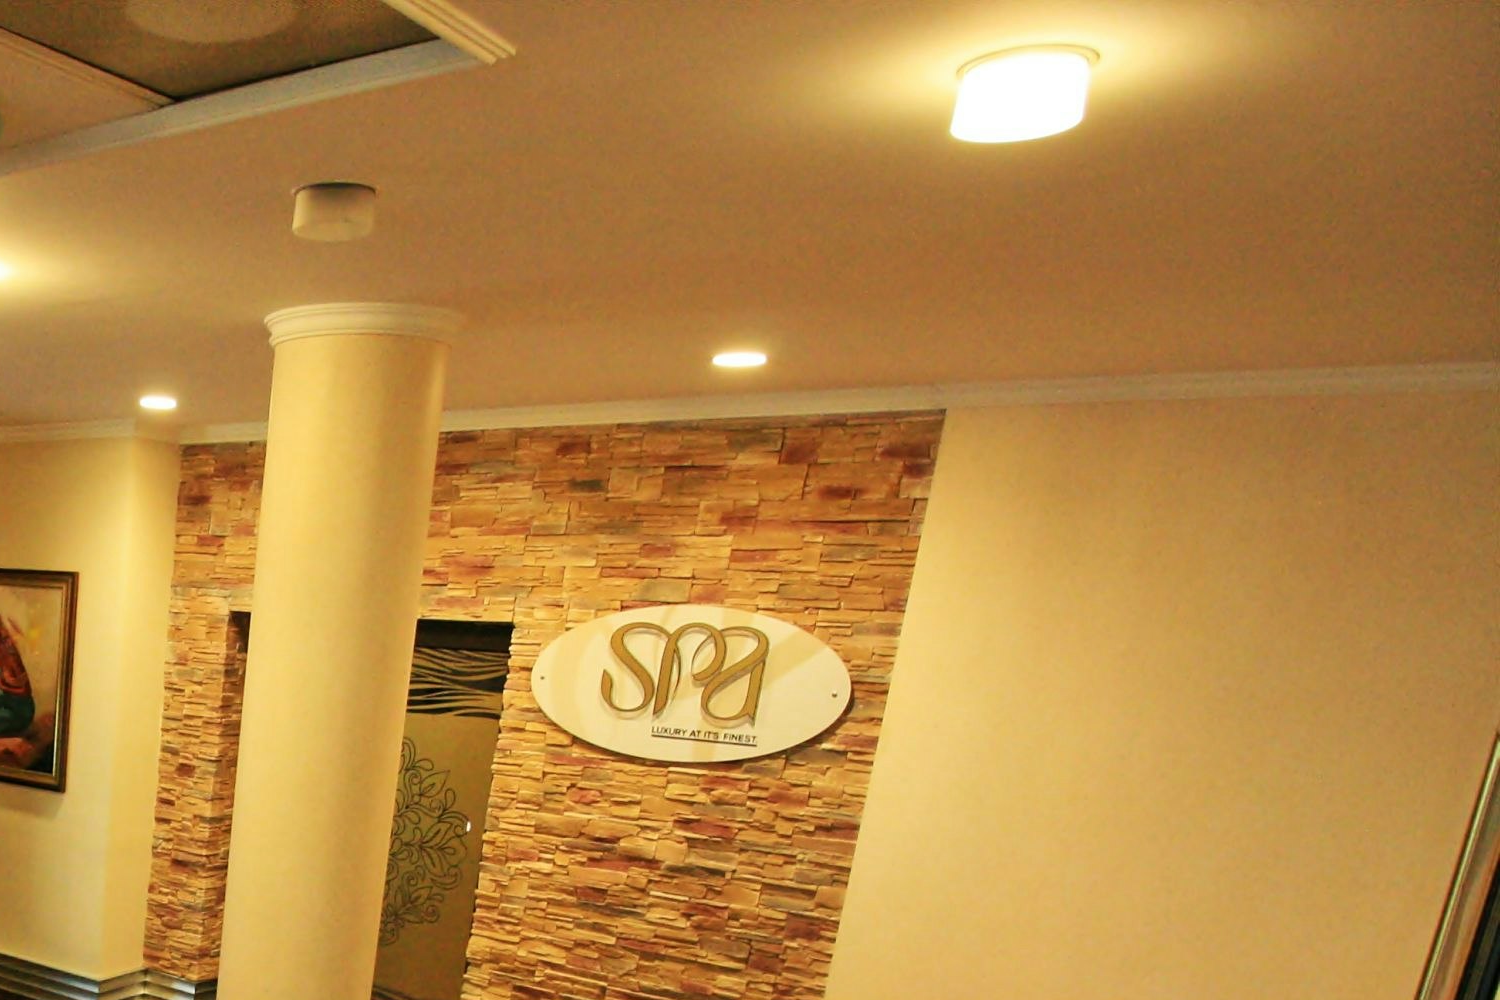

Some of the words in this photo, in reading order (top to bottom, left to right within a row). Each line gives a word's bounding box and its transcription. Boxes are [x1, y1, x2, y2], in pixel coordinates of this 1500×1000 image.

[651, 725, 688, 736] LUXURY
[689, 729, 702, 738] AT
[703, 731, 720, 740] IT'S
[722, 733, 757, 743] FINEST
